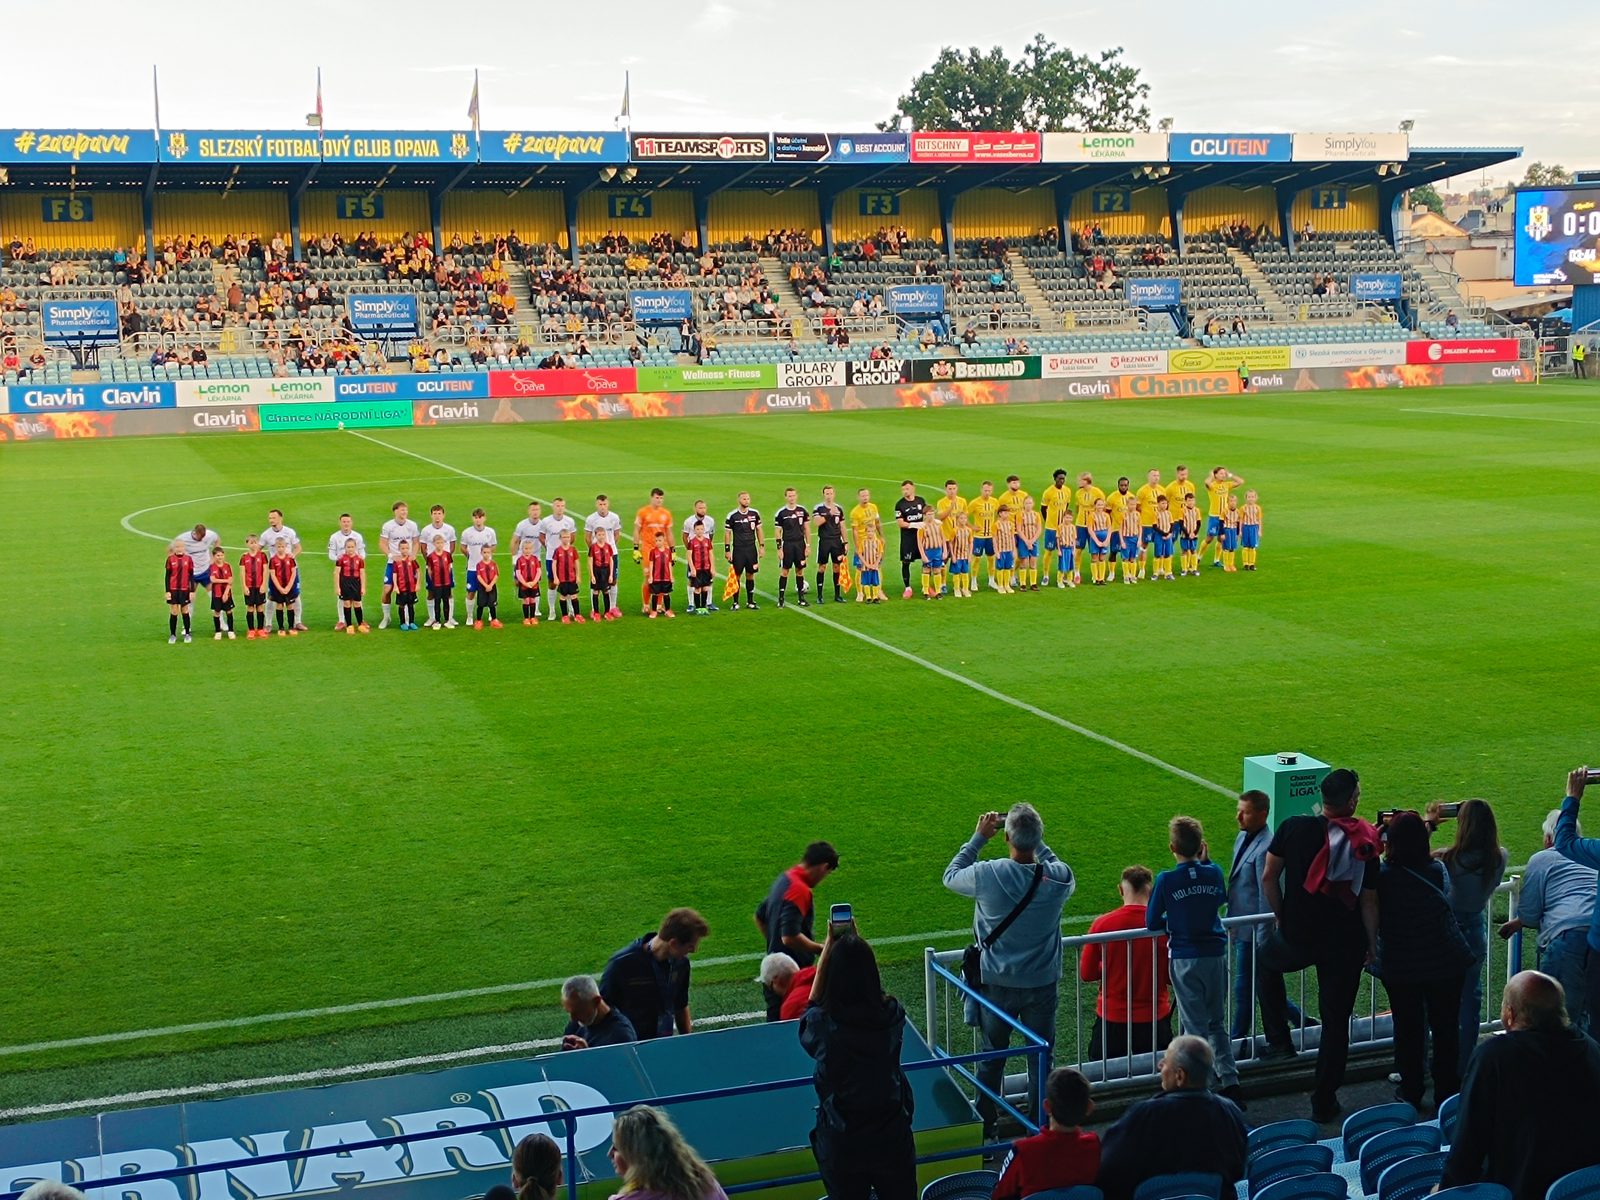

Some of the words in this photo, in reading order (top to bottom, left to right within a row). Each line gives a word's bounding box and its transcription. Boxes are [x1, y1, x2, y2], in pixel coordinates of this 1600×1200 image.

[200, 135, 263, 157] SLEZSKÝ
[354, 139, 391, 157] CLUB
[395, 139, 440, 157] OPAVA
[855, 144, 873, 153] BEST
[874, 143, 906, 153] ACCOUNT
[917, 140, 961, 150] RITSCHNY
[1083, 137, 1134, 148] Lemon
[1190, 138, 1268, 156] OCUTEIN
[1325, 137, 1376, 151] SimplyYou
[1091, 149, 1126, 158] LÉKÁRNA
[1131, 284, 1175, 296] SimplyYou
[1356, 278, 1396, 290] SimplyYou
[634, 295, 685, 308] SimplyYou
[891, 290, 938, 303] SimplyYou
[50, 306, 110, 320] SimplyYou
[354, 300, 410, 313] SimplyYou
[635, 306, 686, 314] Pharmaceuticals
[51, 318, 110, 327] Pharmaceuticals
[355, 312, 410, 320] Pharmaceuticals
[785, 362, 837, 375] PULARY
[851, 360, 905, 374] PULARY
[955, 360, 1025, 378] BERNARD
[1492, 366, 1521, 377] Clavin
[682, 370, 724, 380] Wellness
[728, 369, 761, 378] Fitness
[1252, 374, 1283, 386] Clavin
[198, 383, 250, 394] Lemon
[271, 382, 322, 392] Lemon
[339, 382, 397, 395] OCUTEIN
[417, 380, 473, 393] OCUTEIN
[514, 381, 545, 393] Opava
[587, 379, 617, 391] Opava
[1068, 380, 1110, 395] Clavin
[1130, 375, 1230, 397] Chance
[24, 388, 85, 407] Clavin
[102, 386, 161, 405] Clavin
[766, 392, 811, 407] Clavin
[266, 413, 311, 423] Chance
[315, 408, 372, 421] NÁRODNÍ
[429, 402, 479, 418] Clavin
[193, 410, 247, 427] Clavin
[1290, 786, 1315, 797] LIGA
